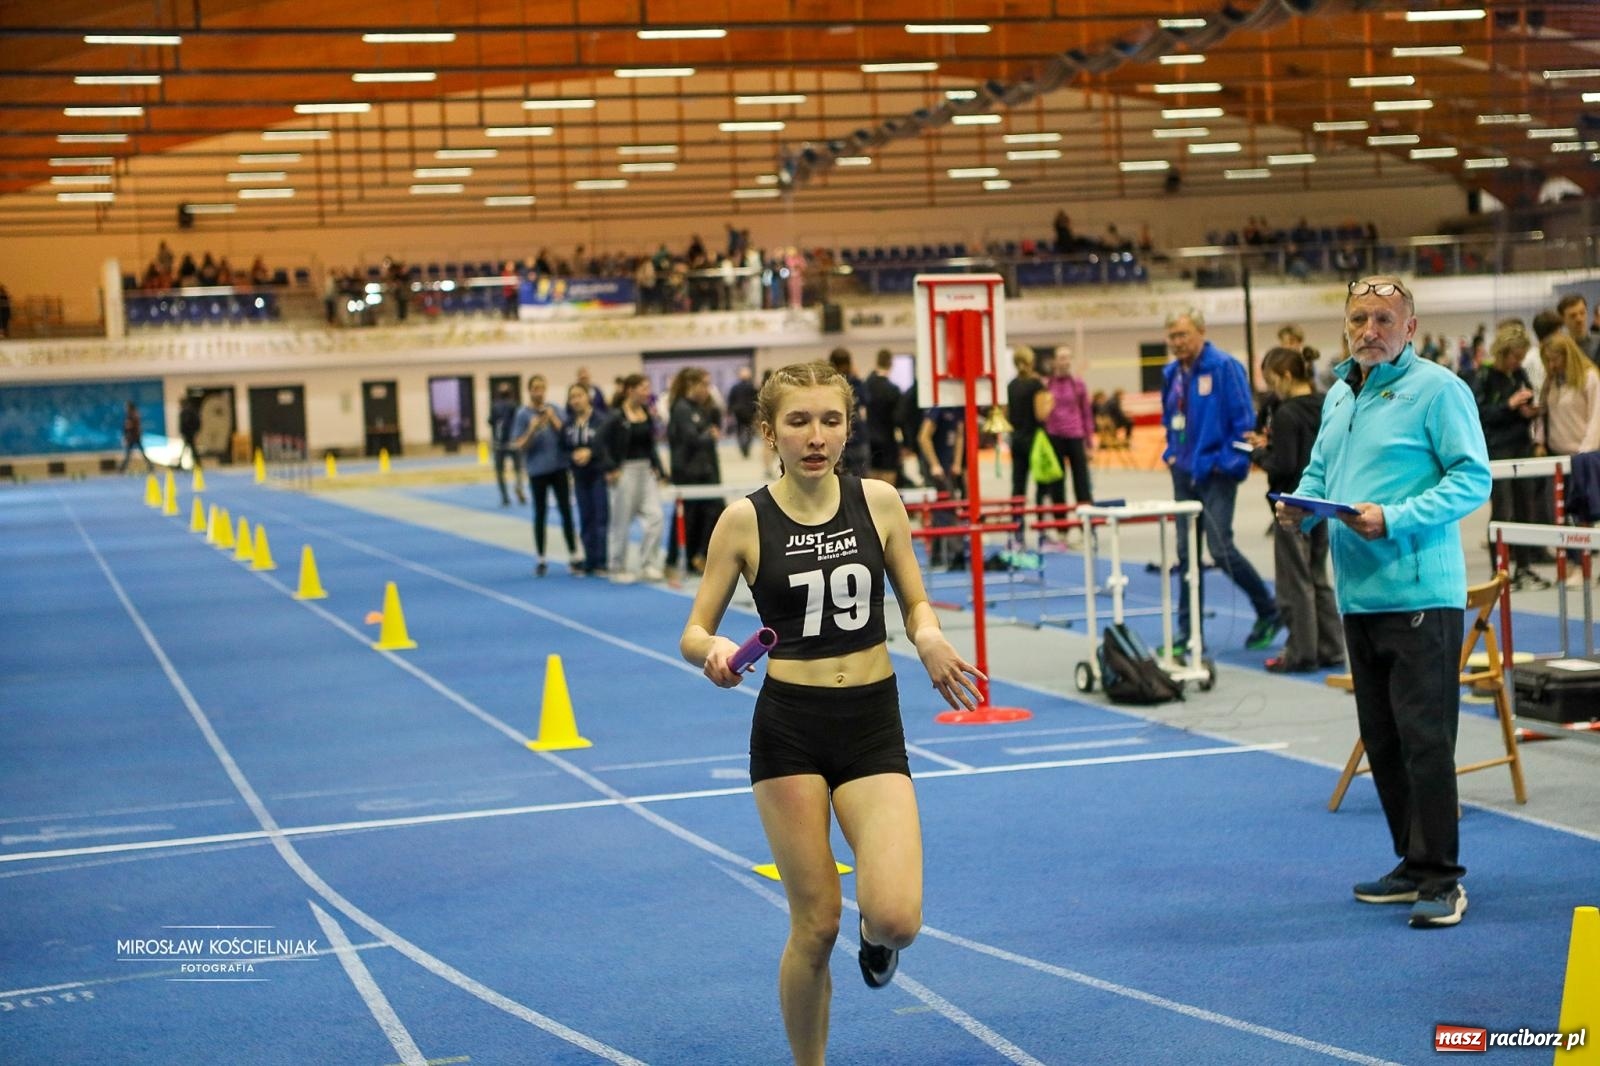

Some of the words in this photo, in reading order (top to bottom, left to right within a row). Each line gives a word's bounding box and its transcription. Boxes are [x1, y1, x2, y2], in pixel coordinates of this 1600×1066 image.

[786, 532, 825, 547] JUST
[815, 536, 857, 555] TEAM
[788, 563, 872, 637] 79
